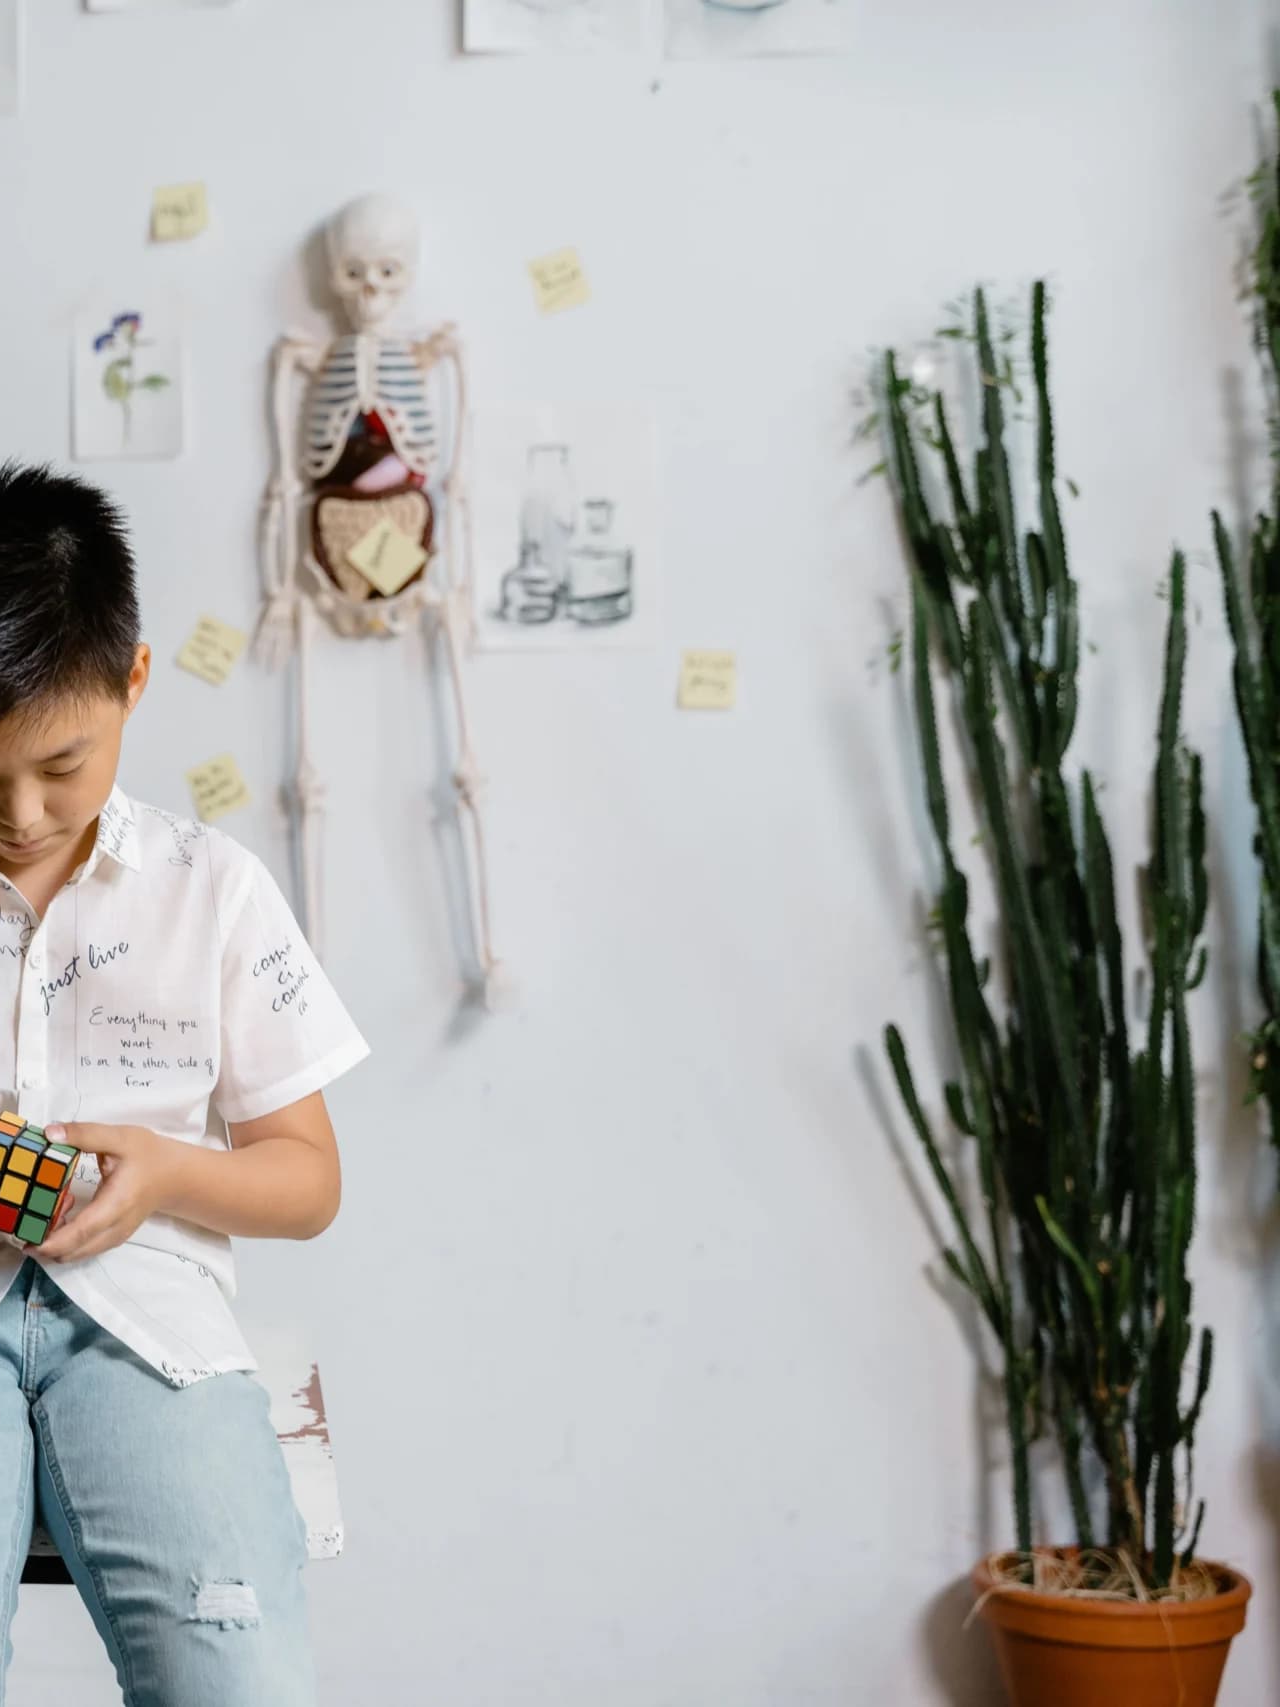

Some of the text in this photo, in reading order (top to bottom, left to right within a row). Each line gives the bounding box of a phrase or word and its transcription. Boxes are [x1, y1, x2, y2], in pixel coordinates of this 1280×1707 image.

[38, 941, 129, 1017] just live
[88, 1005, 198, 1035] Everything you
[119, 1054, 136, 1068] the
[142, 1056, 170, 1069] other
[204, 1057, 214, 1077] of
